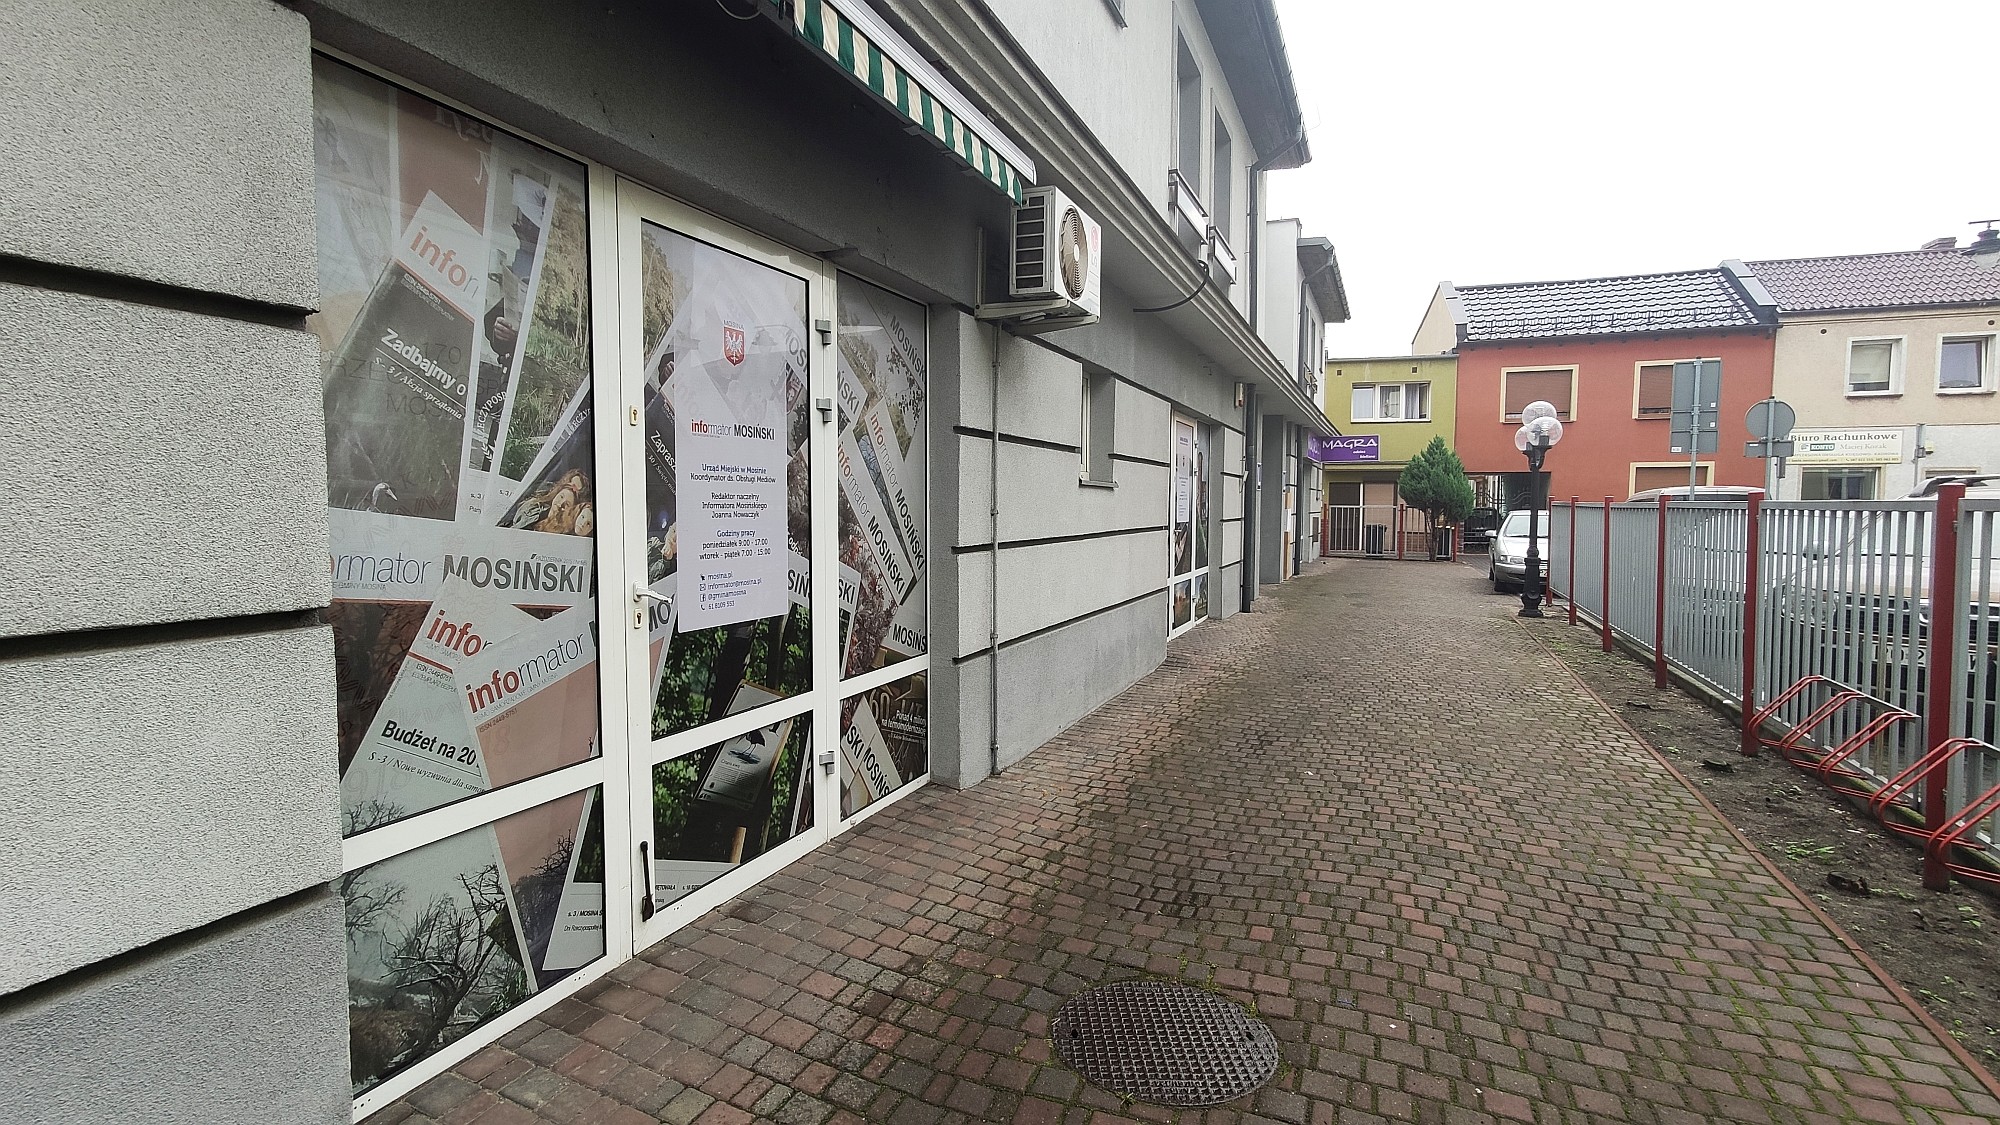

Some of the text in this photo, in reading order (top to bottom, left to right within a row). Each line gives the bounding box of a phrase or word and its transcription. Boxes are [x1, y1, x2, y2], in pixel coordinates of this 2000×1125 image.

[381, 327, 457, 390] Zadbajmy
[400, 375, 424, 394] Akcja
[423, 389, 463, 420] sprzątania
[691, 418, 775, 441] informator MOSIŃSKI
[1322, 438, 1378, 449] MAGRA
[1790, 433, 1898, 442] Biuro Rachunkowe
[702, 463, 719, 473] Urząd
[720, 464, 740, 474] Miejski
[746, 466, 767, 474] Mosinie
[690, 472, 726, 483] Koordynator
[735, 474, 756, 484] Obsługi
[756, 475, 777, 483] Mediów
[711, 492, 760, 501] Redaktor naczelny
[870, 411, 925, 570] informator MOSIŃSKI
[702, 501, 768, 510] Informatora Mosińskiego
[711, 510, 760, 520] Joanna Nowaczyk
[716, 530, 740, 538] Godziny
[702, 540, 738, 551] poniedziałek
[699, 551, 720, 560] wtorek
[724, 550, 741, 560] piątek
[868, 515, 905, 594] MOSIŃSKI
[329, 552, 584, 593] rmator MOSIŃSKI
[707, 571, 733, 581] mosina.pl
[707, 578, 762, 590] informator@mosina.pl
[788, 569, 810, 598] SIŃ
[649, 594, 675, 632] MO
[465, 633, 584, 714] informator
[381, 719, 479, 768] Budżet na 20
[393, 759, 417, 774] Nowe
[416, 767, 452, 785] wyzwania
[452, 777, 464, 788] dla
